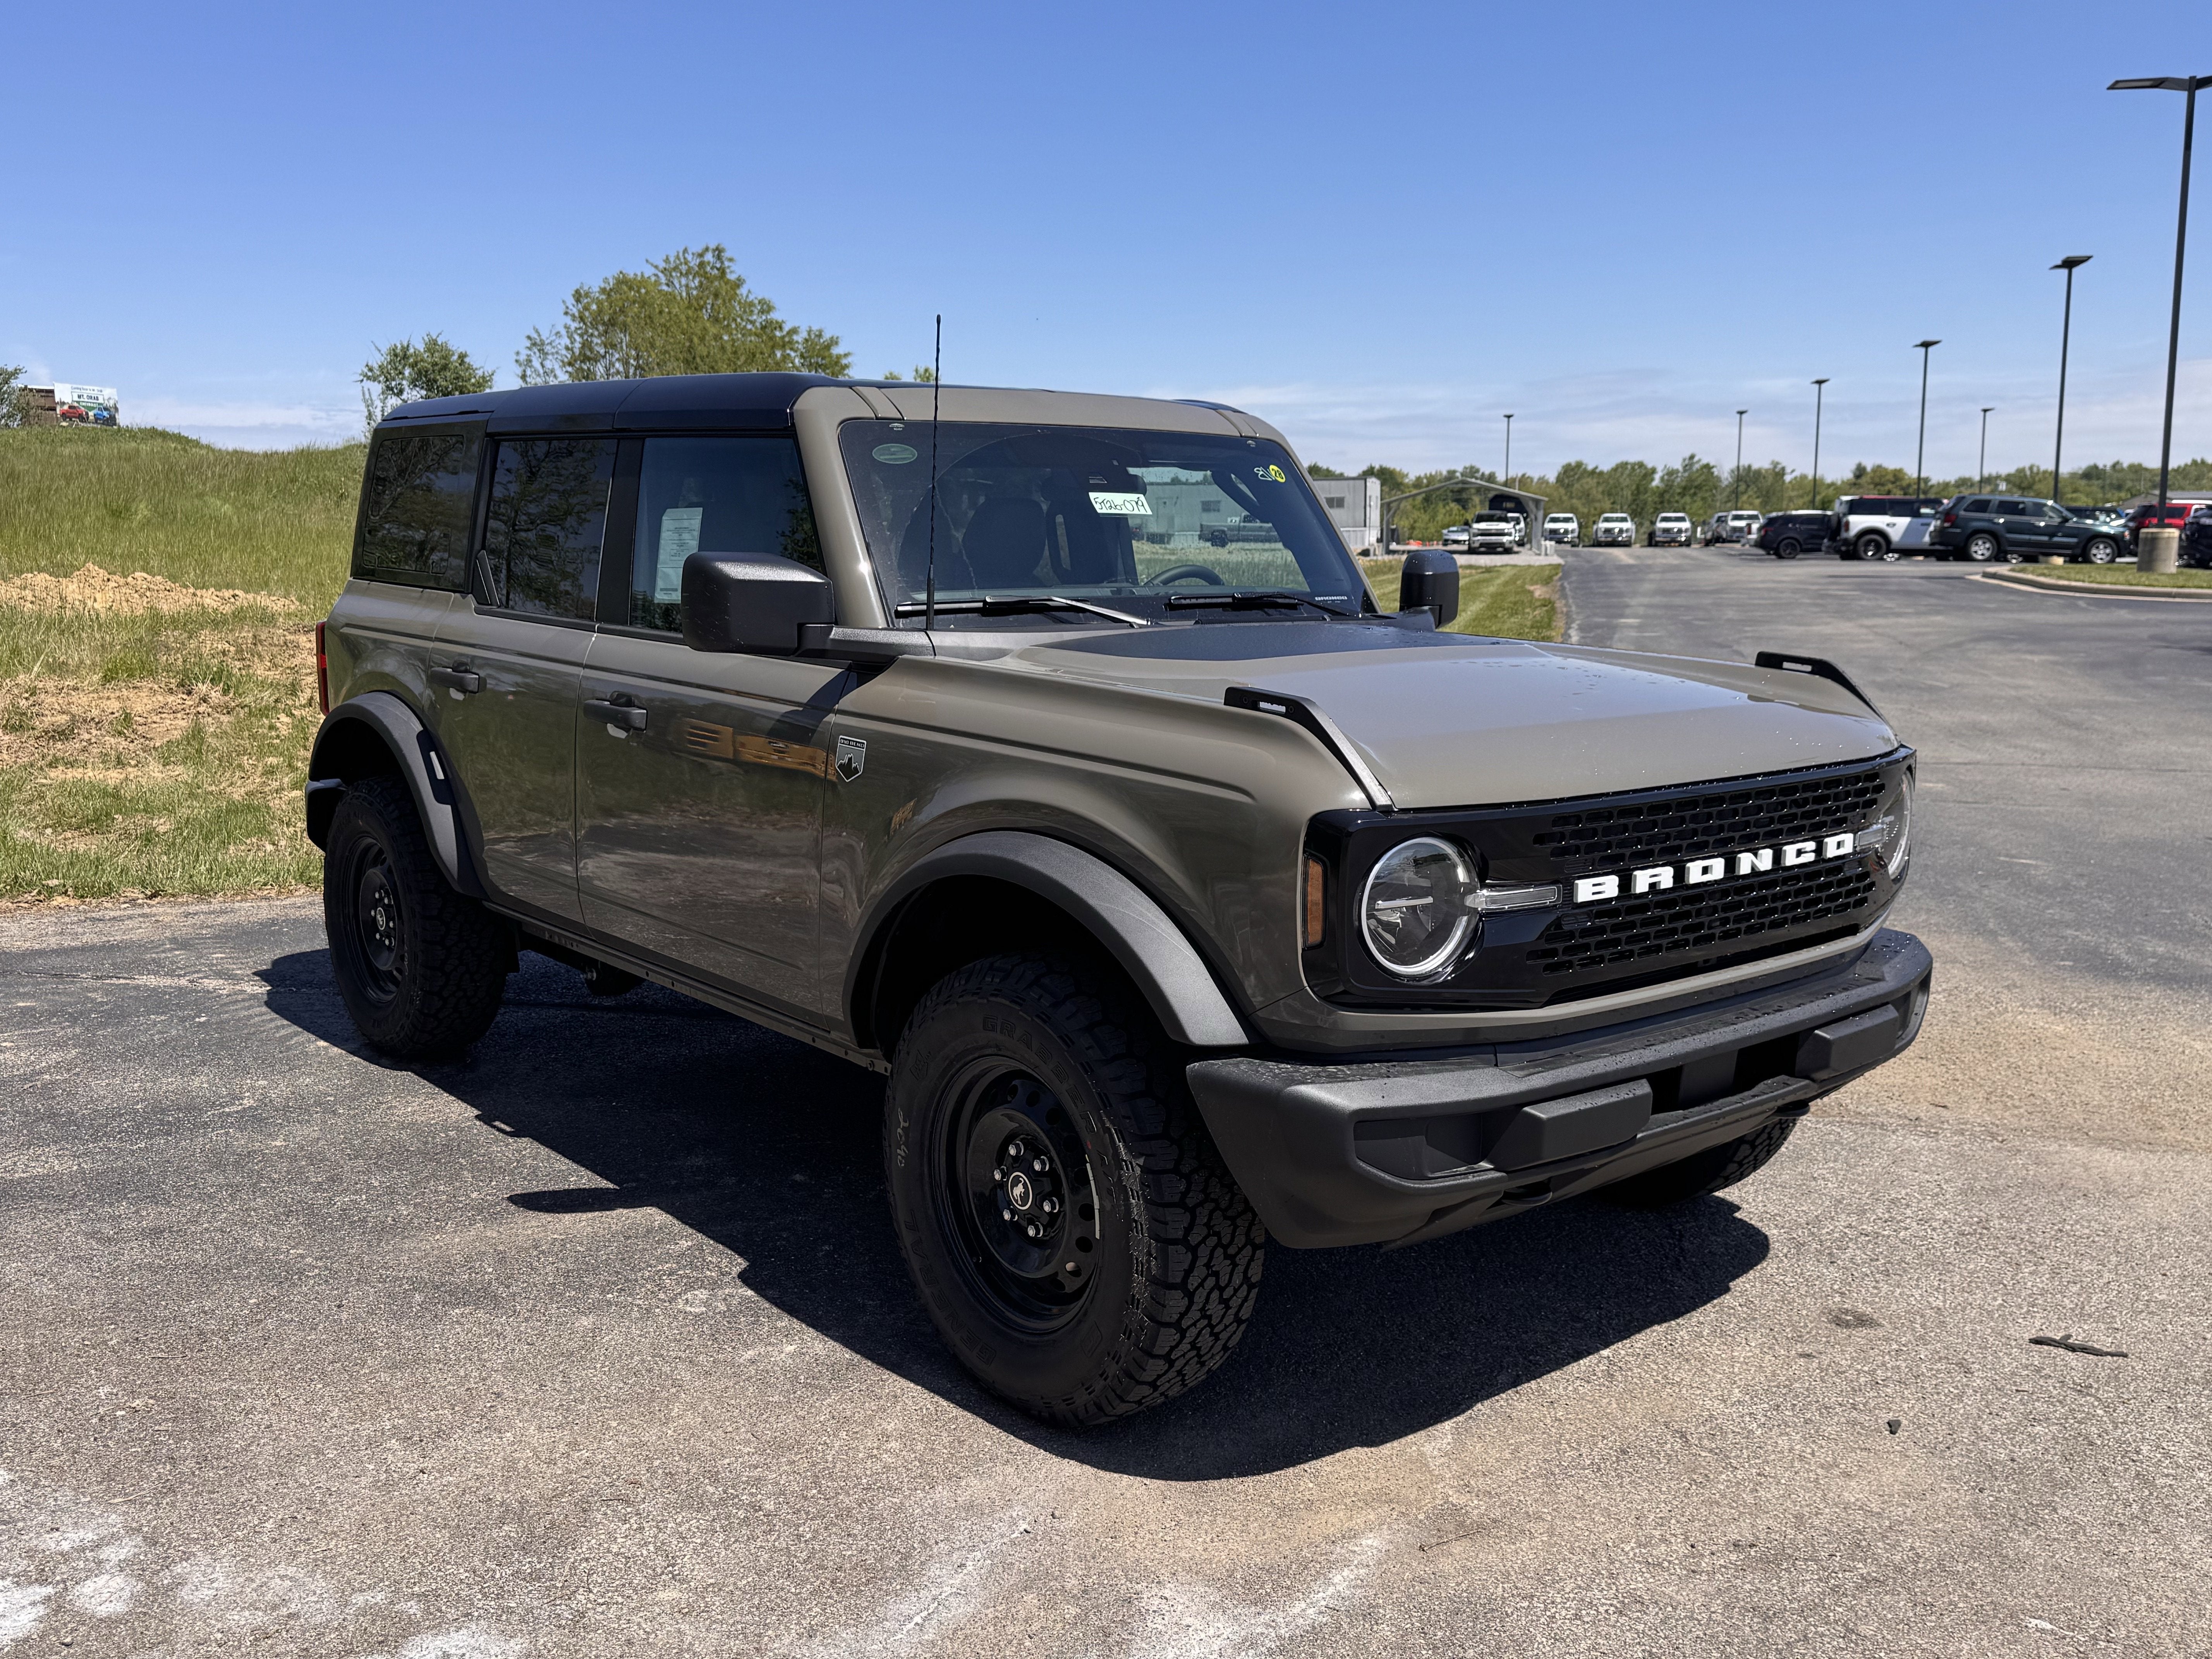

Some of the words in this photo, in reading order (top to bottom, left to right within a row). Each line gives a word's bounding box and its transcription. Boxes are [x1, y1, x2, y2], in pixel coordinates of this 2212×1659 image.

[1271, 468, 1284, 479] 28
[1573, 833, 1854, 903] BRONCO
[982, 1015, 1097, 1134] GRABBER
[904, 1209, 996, 1367] GENERAL
